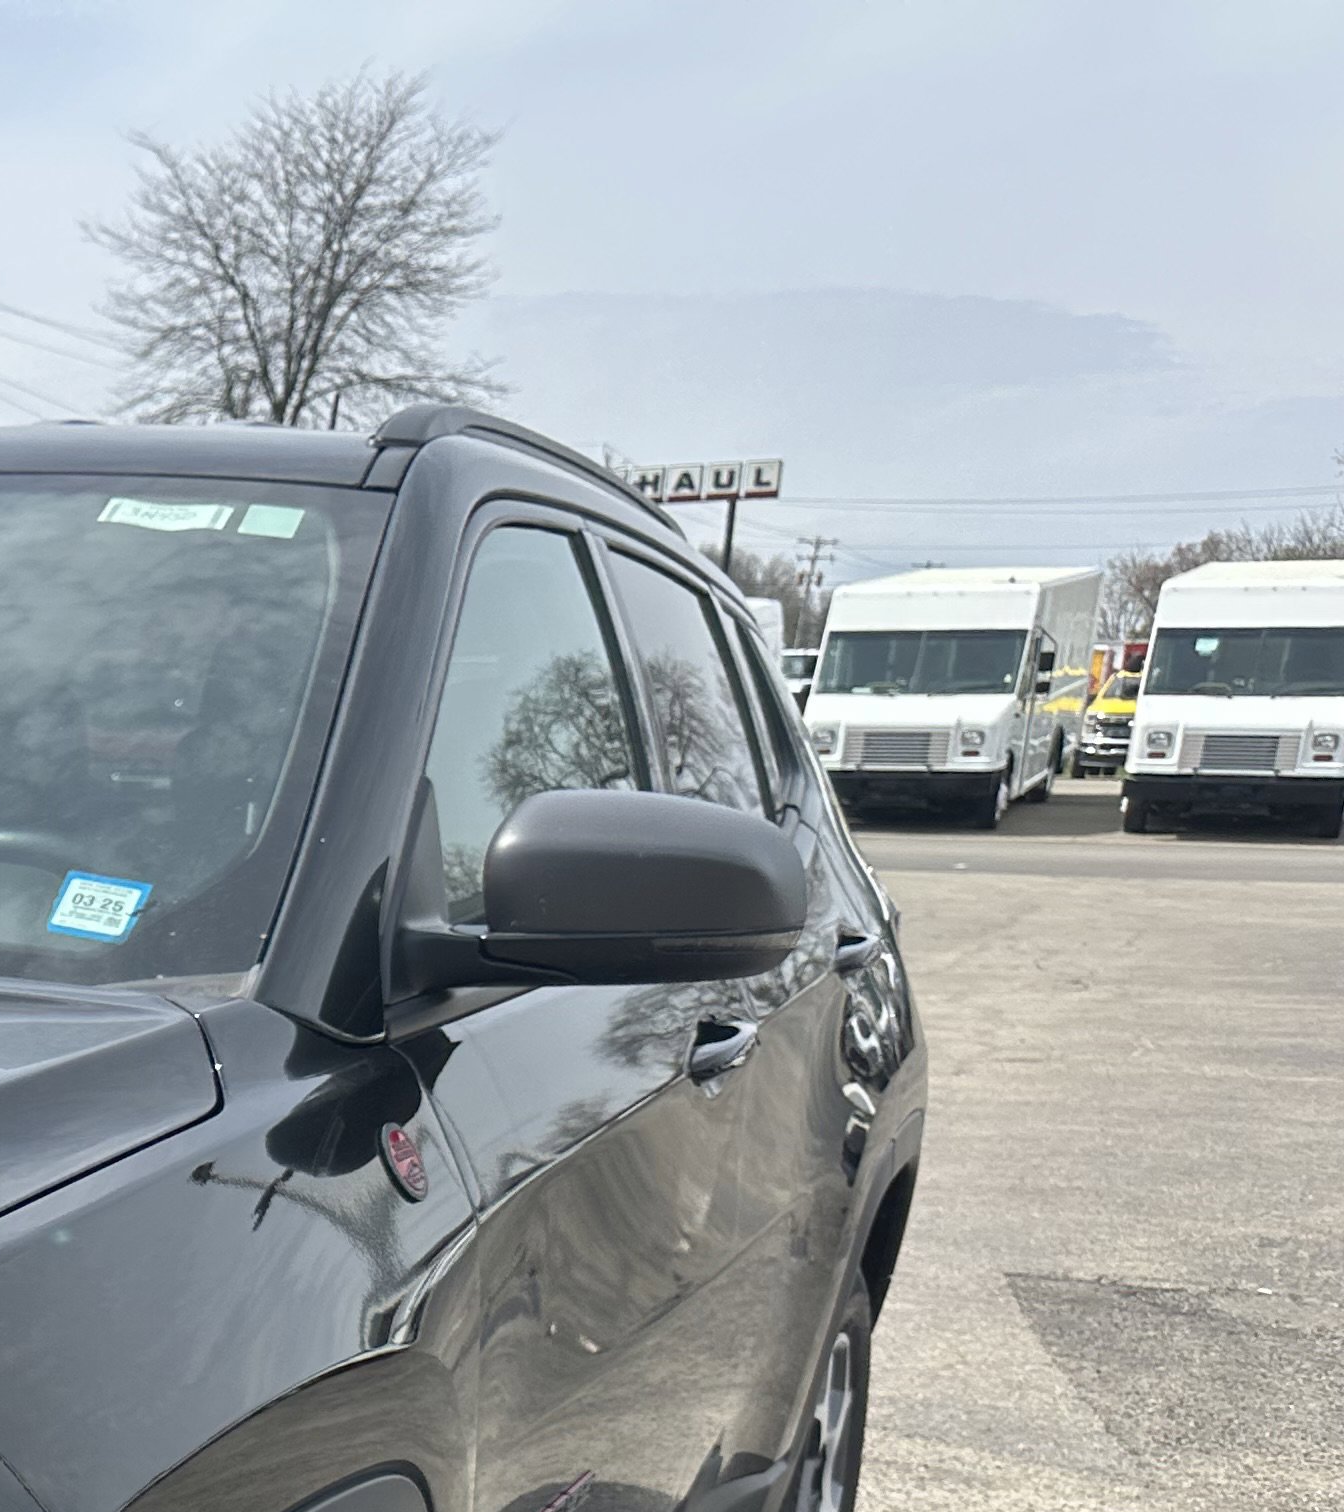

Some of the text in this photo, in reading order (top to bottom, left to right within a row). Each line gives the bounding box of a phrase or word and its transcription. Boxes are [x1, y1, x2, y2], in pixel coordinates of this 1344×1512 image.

[633, 468, 771, 492] HAUL
[72, 893, 96, 906] 03
[100, 898, 126, 912] 25
